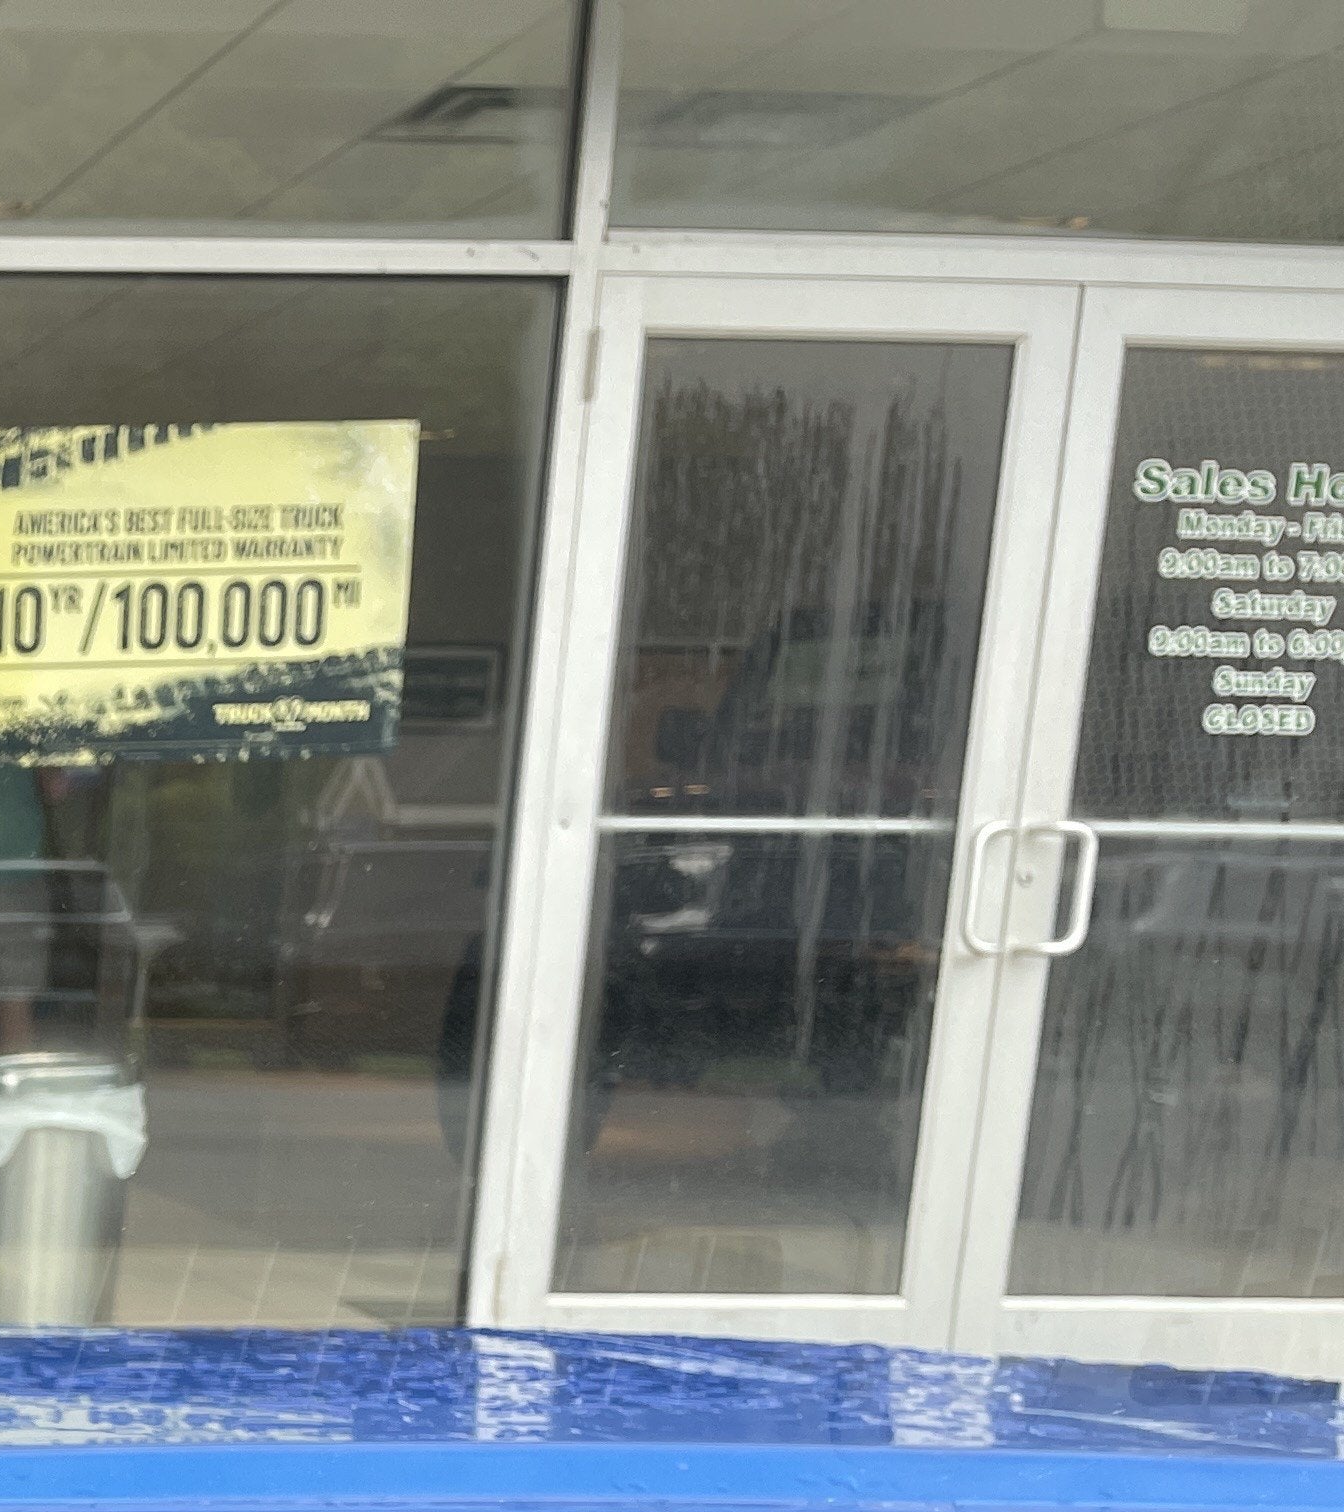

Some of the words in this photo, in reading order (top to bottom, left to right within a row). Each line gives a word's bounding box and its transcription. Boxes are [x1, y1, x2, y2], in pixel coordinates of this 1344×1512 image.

[1134, 458, 1277, 503] Sales
[13, 508, 120, 536] AMERICA'S
[124, 505, 174, 534] BEST
[177, 504, 274, 533] FULL-SIZE
[279, 503, 344, 530] TRUCK
[1177, 508, 1287, 546] Monday
[11, 540, 144, 566] POWERTRAIN
[147, 537, 228, 563] LIMITED
[230, 533, 344, 561] WARRANTY
[1262, 550, 1295, 581] to
[1296, 550, 1344, 582] 7:0
[1211, 587, 1337, 626] Saturday
[1253, 628, 1285, 659] to
[1213, 665, 1317, 702] Sunday
[1202, 703, 1315, 735] CLOSED
